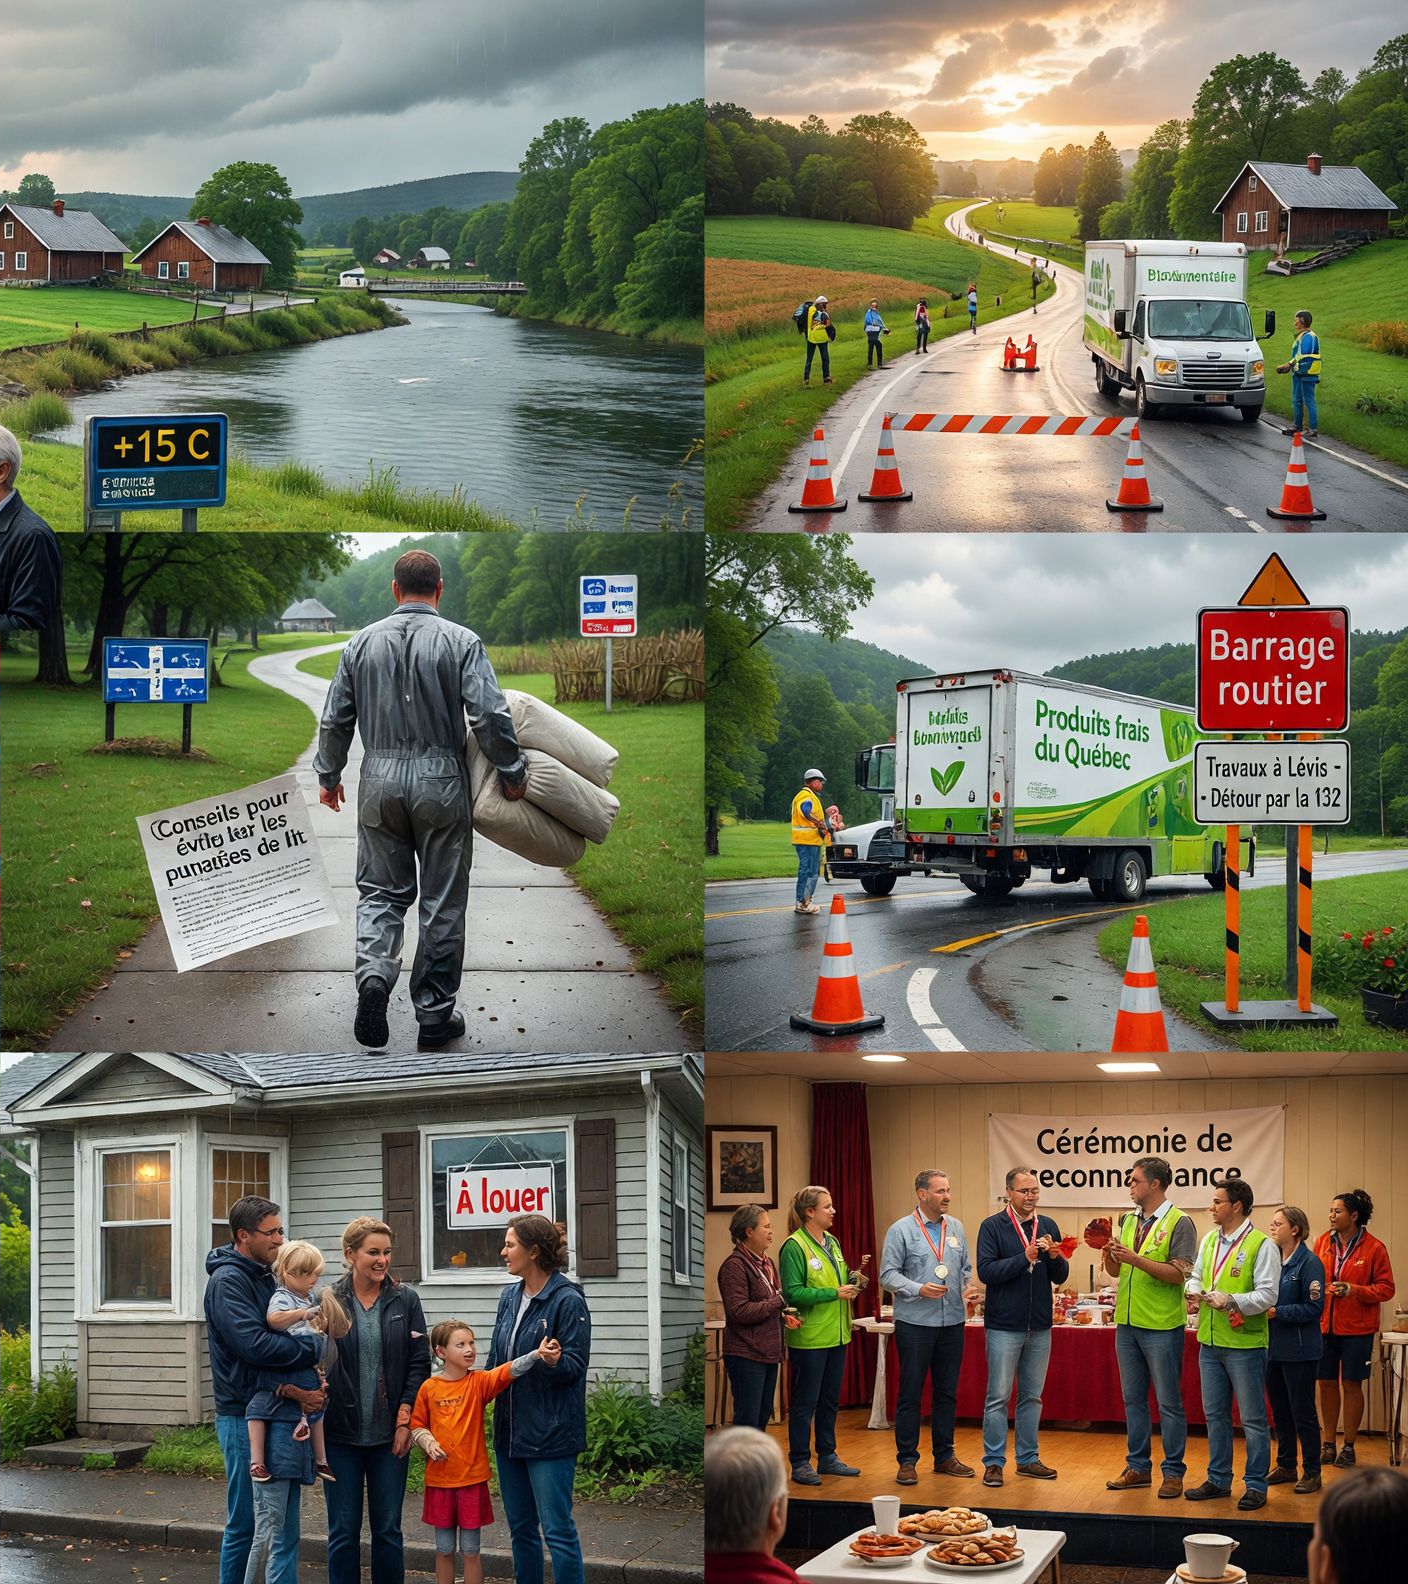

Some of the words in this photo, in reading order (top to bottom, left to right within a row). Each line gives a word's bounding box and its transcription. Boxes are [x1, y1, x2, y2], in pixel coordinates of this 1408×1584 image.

[113, 429, 177, 463] +15
[187, 428, 210, 460] C
[1210, 629, 1335, 670] Barrage
[1218, 673, 1327, 705] routier
[1035, 699, 1111, 737] Produits
[1115, 714, 1150, 743] frais
[1034, 733, 1060, 763] du
[1064, 737, 1131, 770] Québec
[1206, 756, 1268, 777] Travaux
[1273, 757, 1282, 777] à
[1288, 755, 1328, 777] Lévis
[246, 791, 290, 821] pour
[1211, 787, 1262, 808] Détour
[1266, 794, 1290, 815] par
[1296, 787, 1309, 808] la
[1315, 786, 1341, 808] 132
[260, 814, 288, 834] les
[257, 837, 280, 857] de
[1037, 1126, 1187, 1154] Cérémonie
[1197, 1123, 1233, 1152] de
[455, 1178, 474, 1214] À
[481, 1177, 550, 1213] louer
